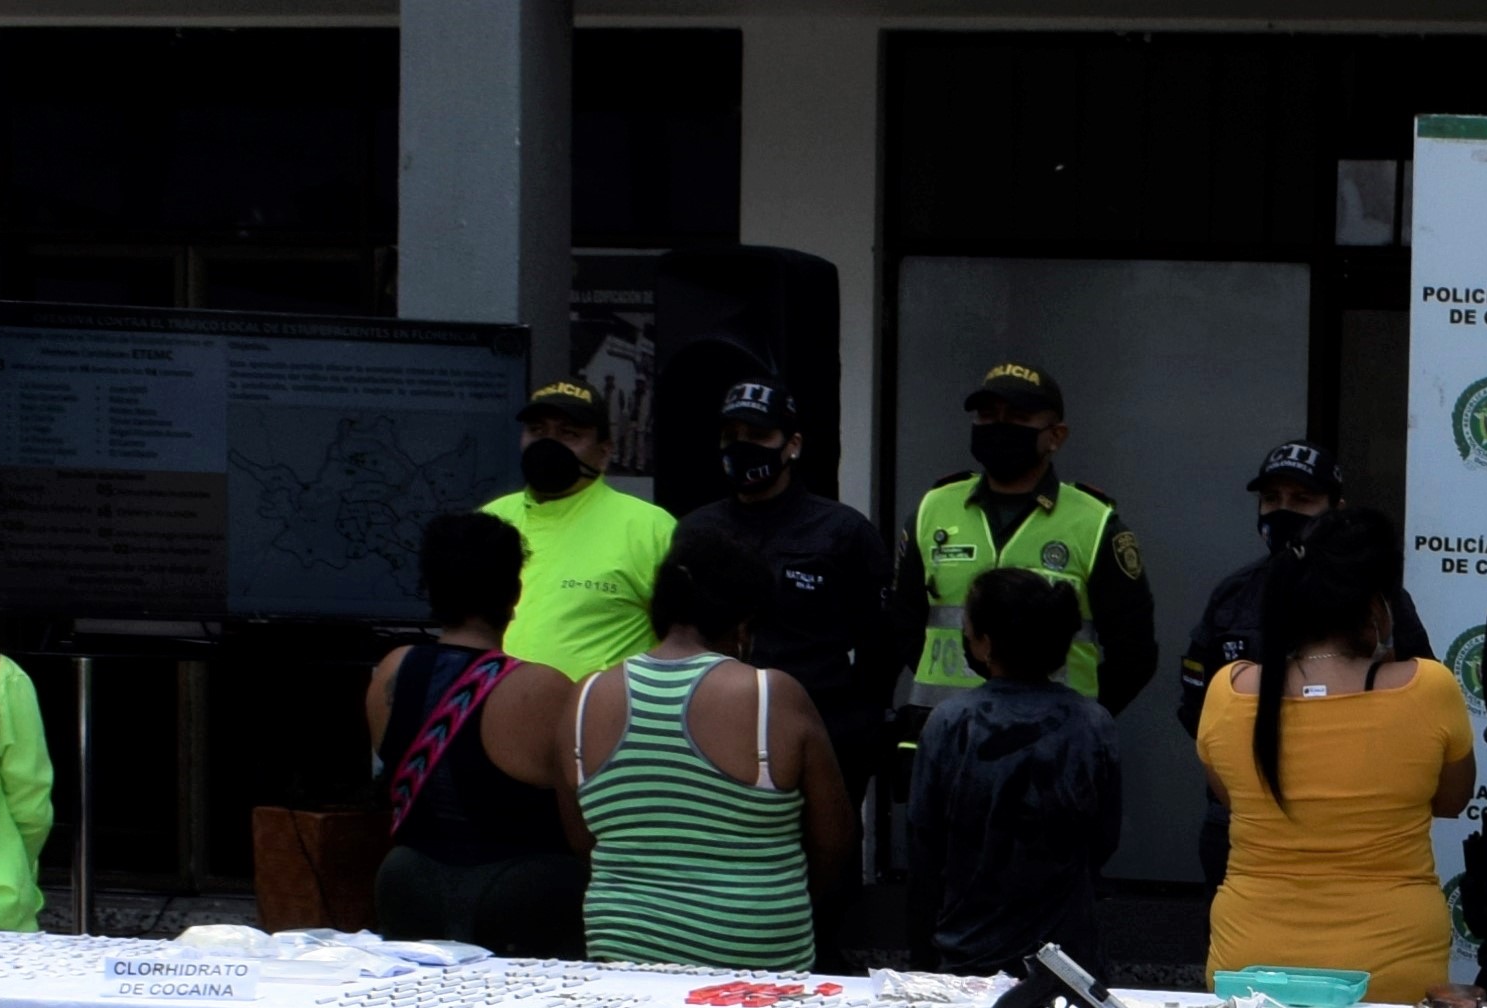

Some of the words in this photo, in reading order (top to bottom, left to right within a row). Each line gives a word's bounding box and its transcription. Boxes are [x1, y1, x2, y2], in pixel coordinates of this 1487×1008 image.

[1449, 309, 1477, 325] DE
[1442, 558, 1468, 573] DE
[113, 961, 249, 977] CLORHIDRATO
[119, 983, 144, 996] DE
[149, 983, 234, 997] COCAINA
